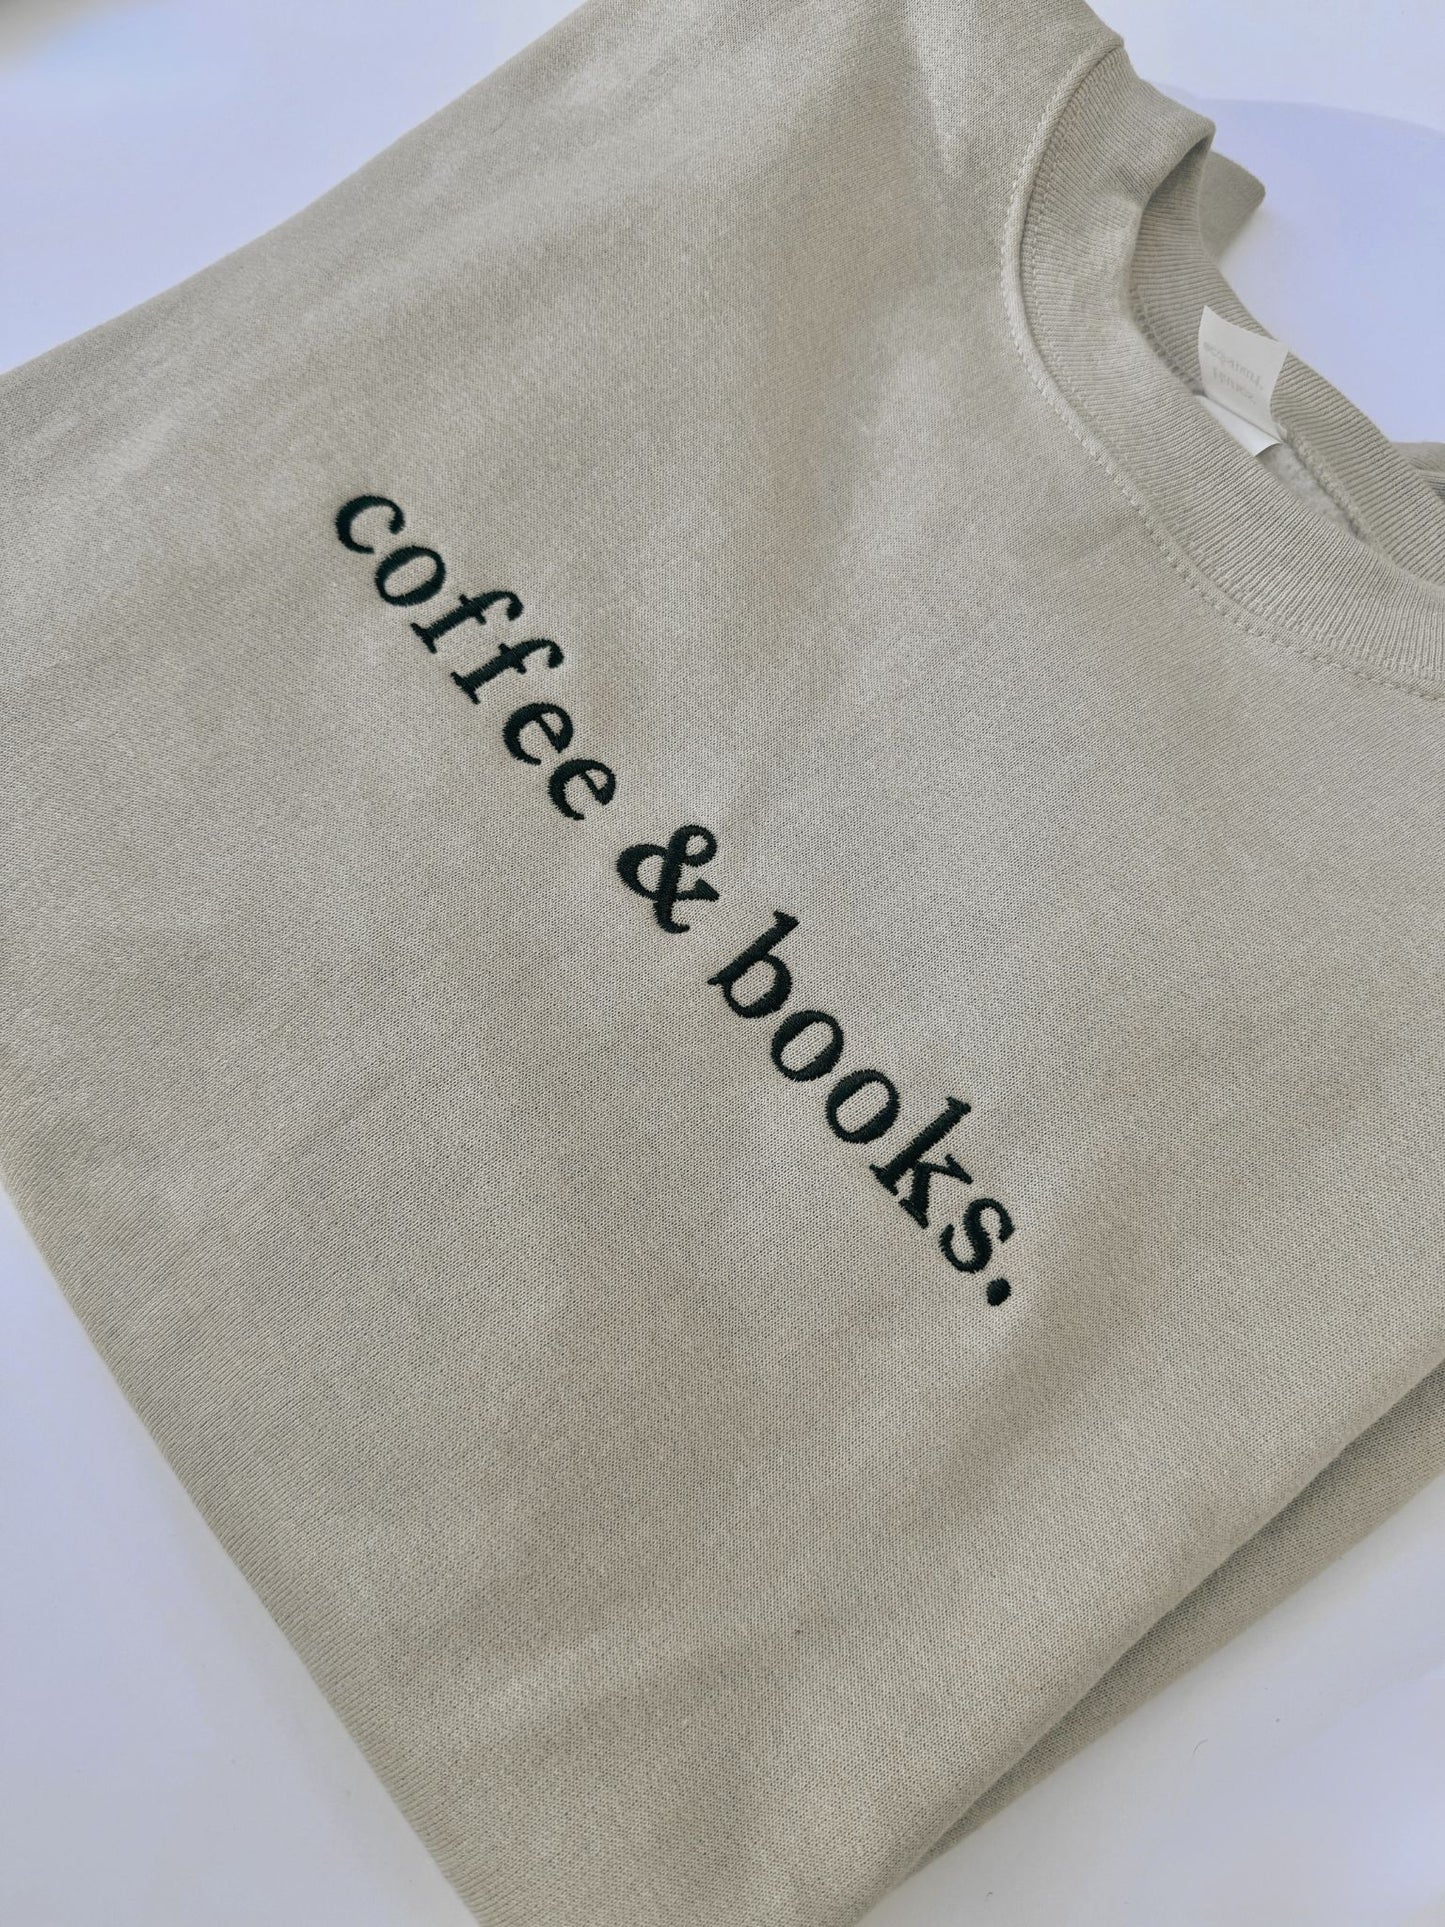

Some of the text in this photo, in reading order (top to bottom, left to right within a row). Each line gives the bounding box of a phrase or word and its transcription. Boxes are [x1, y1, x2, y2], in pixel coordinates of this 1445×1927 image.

[334, 493, 1016, 1307] coffee & books.
